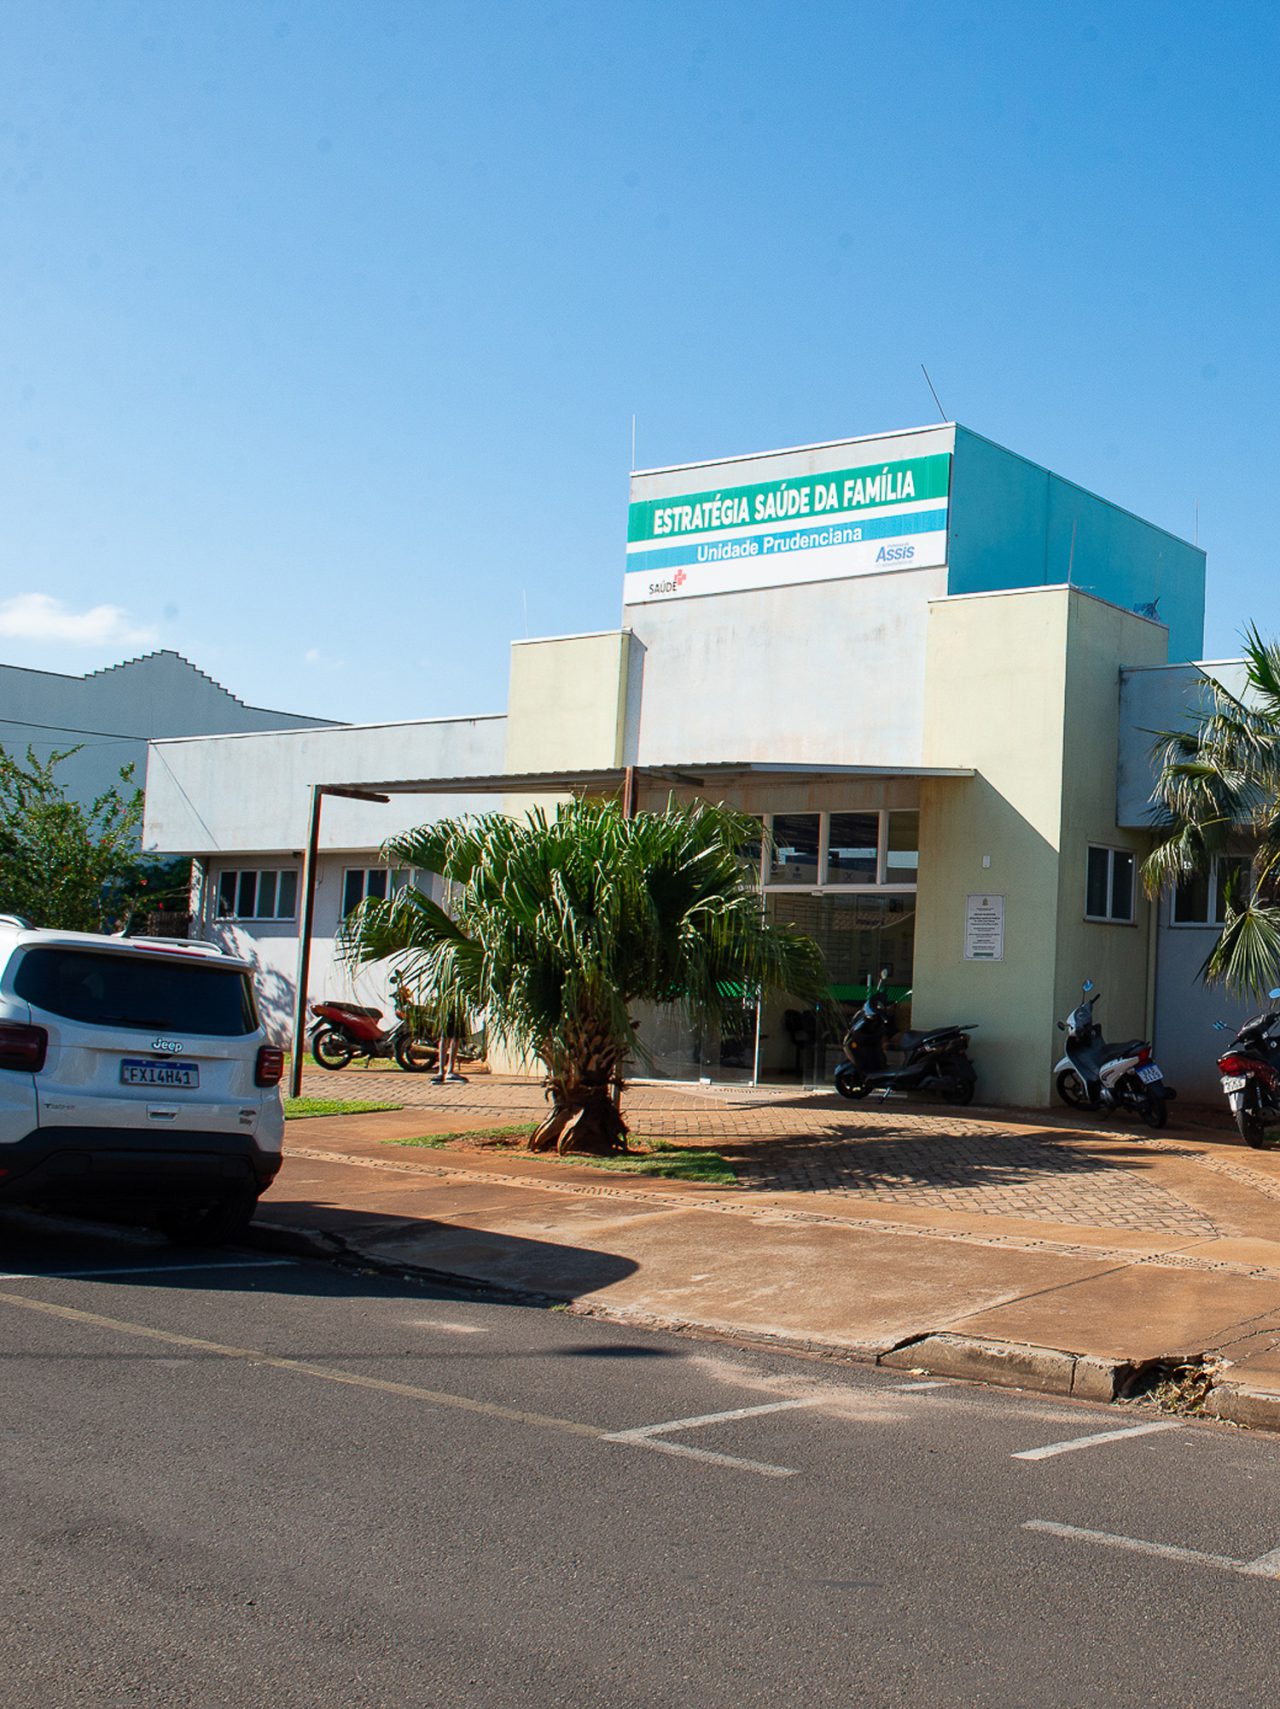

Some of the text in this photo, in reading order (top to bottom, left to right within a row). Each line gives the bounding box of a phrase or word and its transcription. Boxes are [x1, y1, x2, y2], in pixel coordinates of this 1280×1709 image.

[653, 466, 916, 535] ESTRATÉGIA SAÚDE DA FAMÍLIA
[697, 527, 862, 562] Unidade Prudenciana
[875, 545, 915, 563] Assis
[649, 580, 678, 594] SAÚDE
[151, 1037, 184, 1053] Jeep
[130, 1067, 191, 1085] FXI4H41
